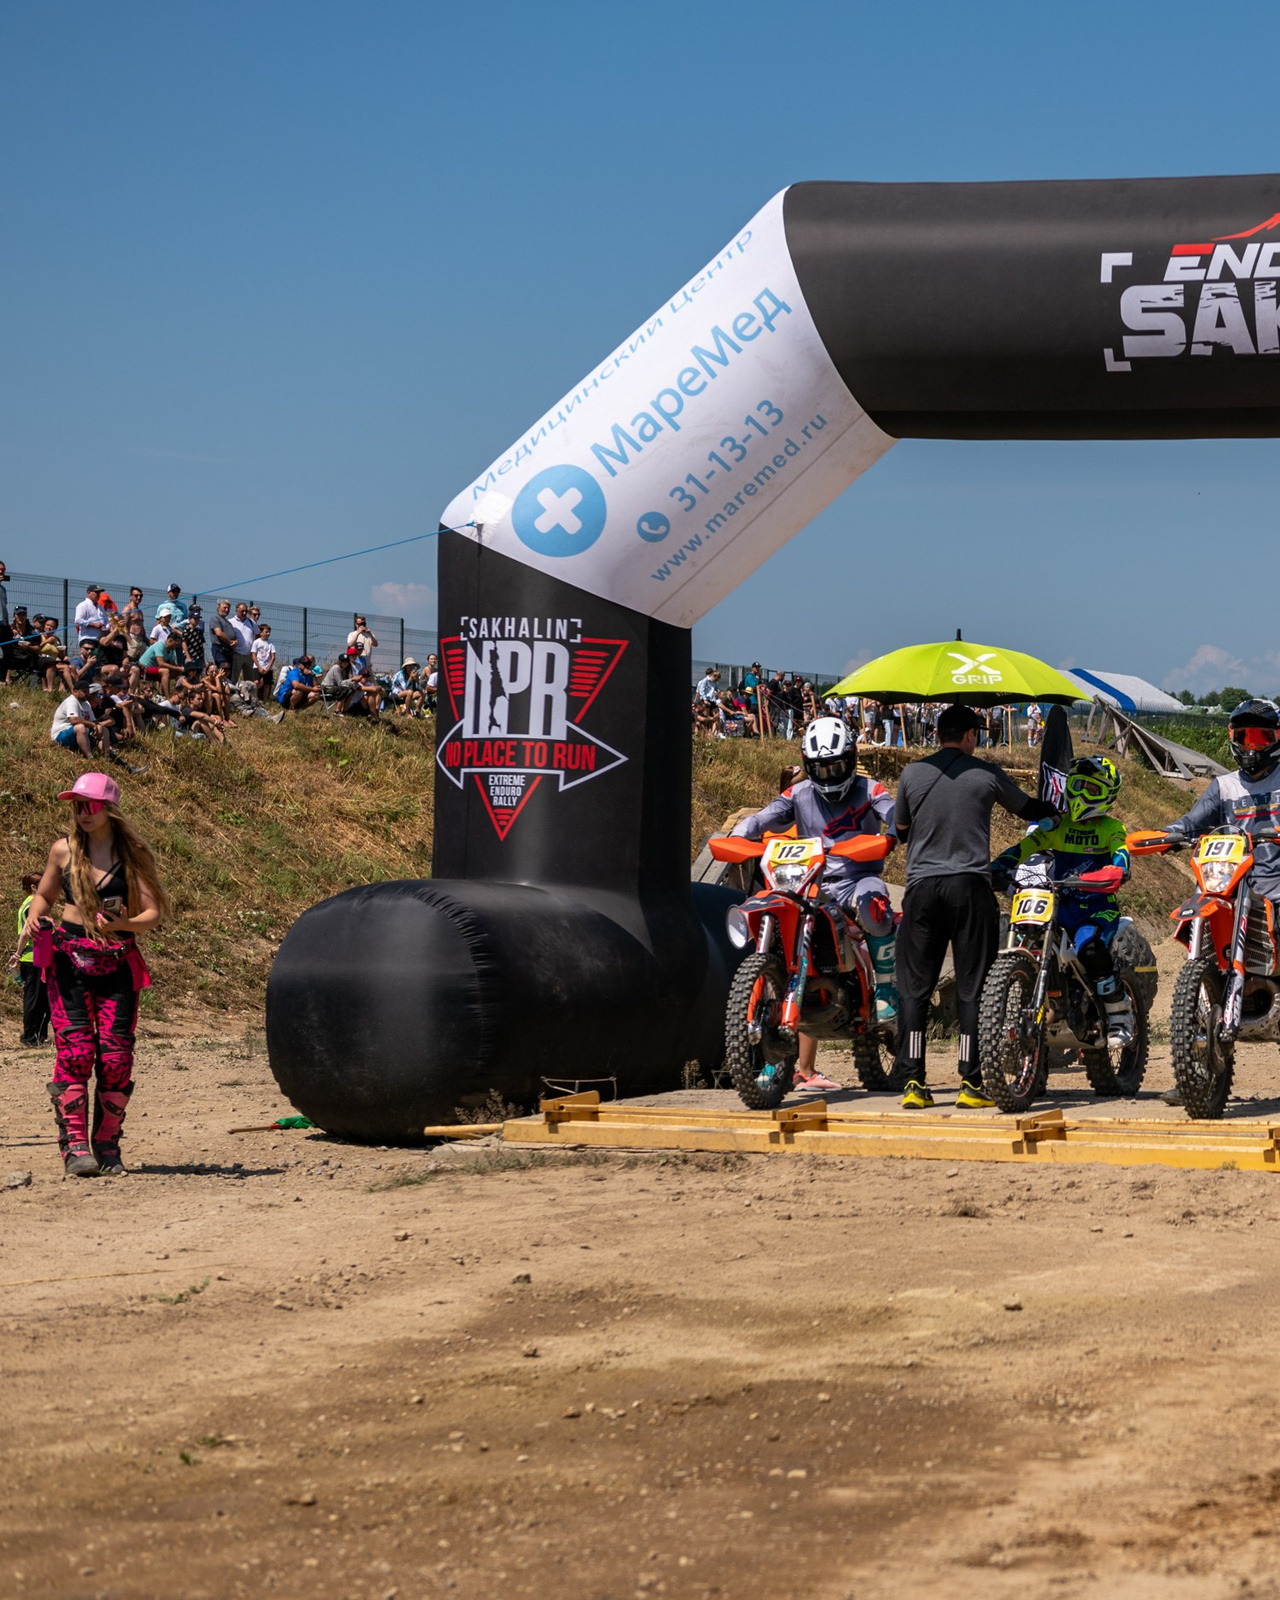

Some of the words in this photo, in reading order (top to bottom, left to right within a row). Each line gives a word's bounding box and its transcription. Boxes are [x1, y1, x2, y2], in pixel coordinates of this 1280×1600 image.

[472, 317, 665, 500] Медицинский
[669, 229, 753, 313] Центр
[589, 287, 793, 478] МареМед
[668, 399, 784, 513] 31-13-13
[650, 414, 828, 583] www.maremed.ru
[469, 616, 568, 640] SAKHALIN
[952, 674, 1003, 685] GRIP
[462, 640, 570, 740] NPR
[445, 741, 461, 768] NO
[464, 740, 517, 767] PLACE
[522, 741, 548, 767] TO
[552, 743, 596, 771] RUN
[488, 774, 526, 787] EXTREME
[489, 786, 522, 797] ENDURO
[492, 796, 518, 806] RALLY
[1232, 794, 1280, 810] LEATT
[1064, 833, 1099, 846] MOTO
[777, 845, 806, 859] 112
[1204, 841, 1235, 857] 191
[1016, 898, 1048, 916] 106
